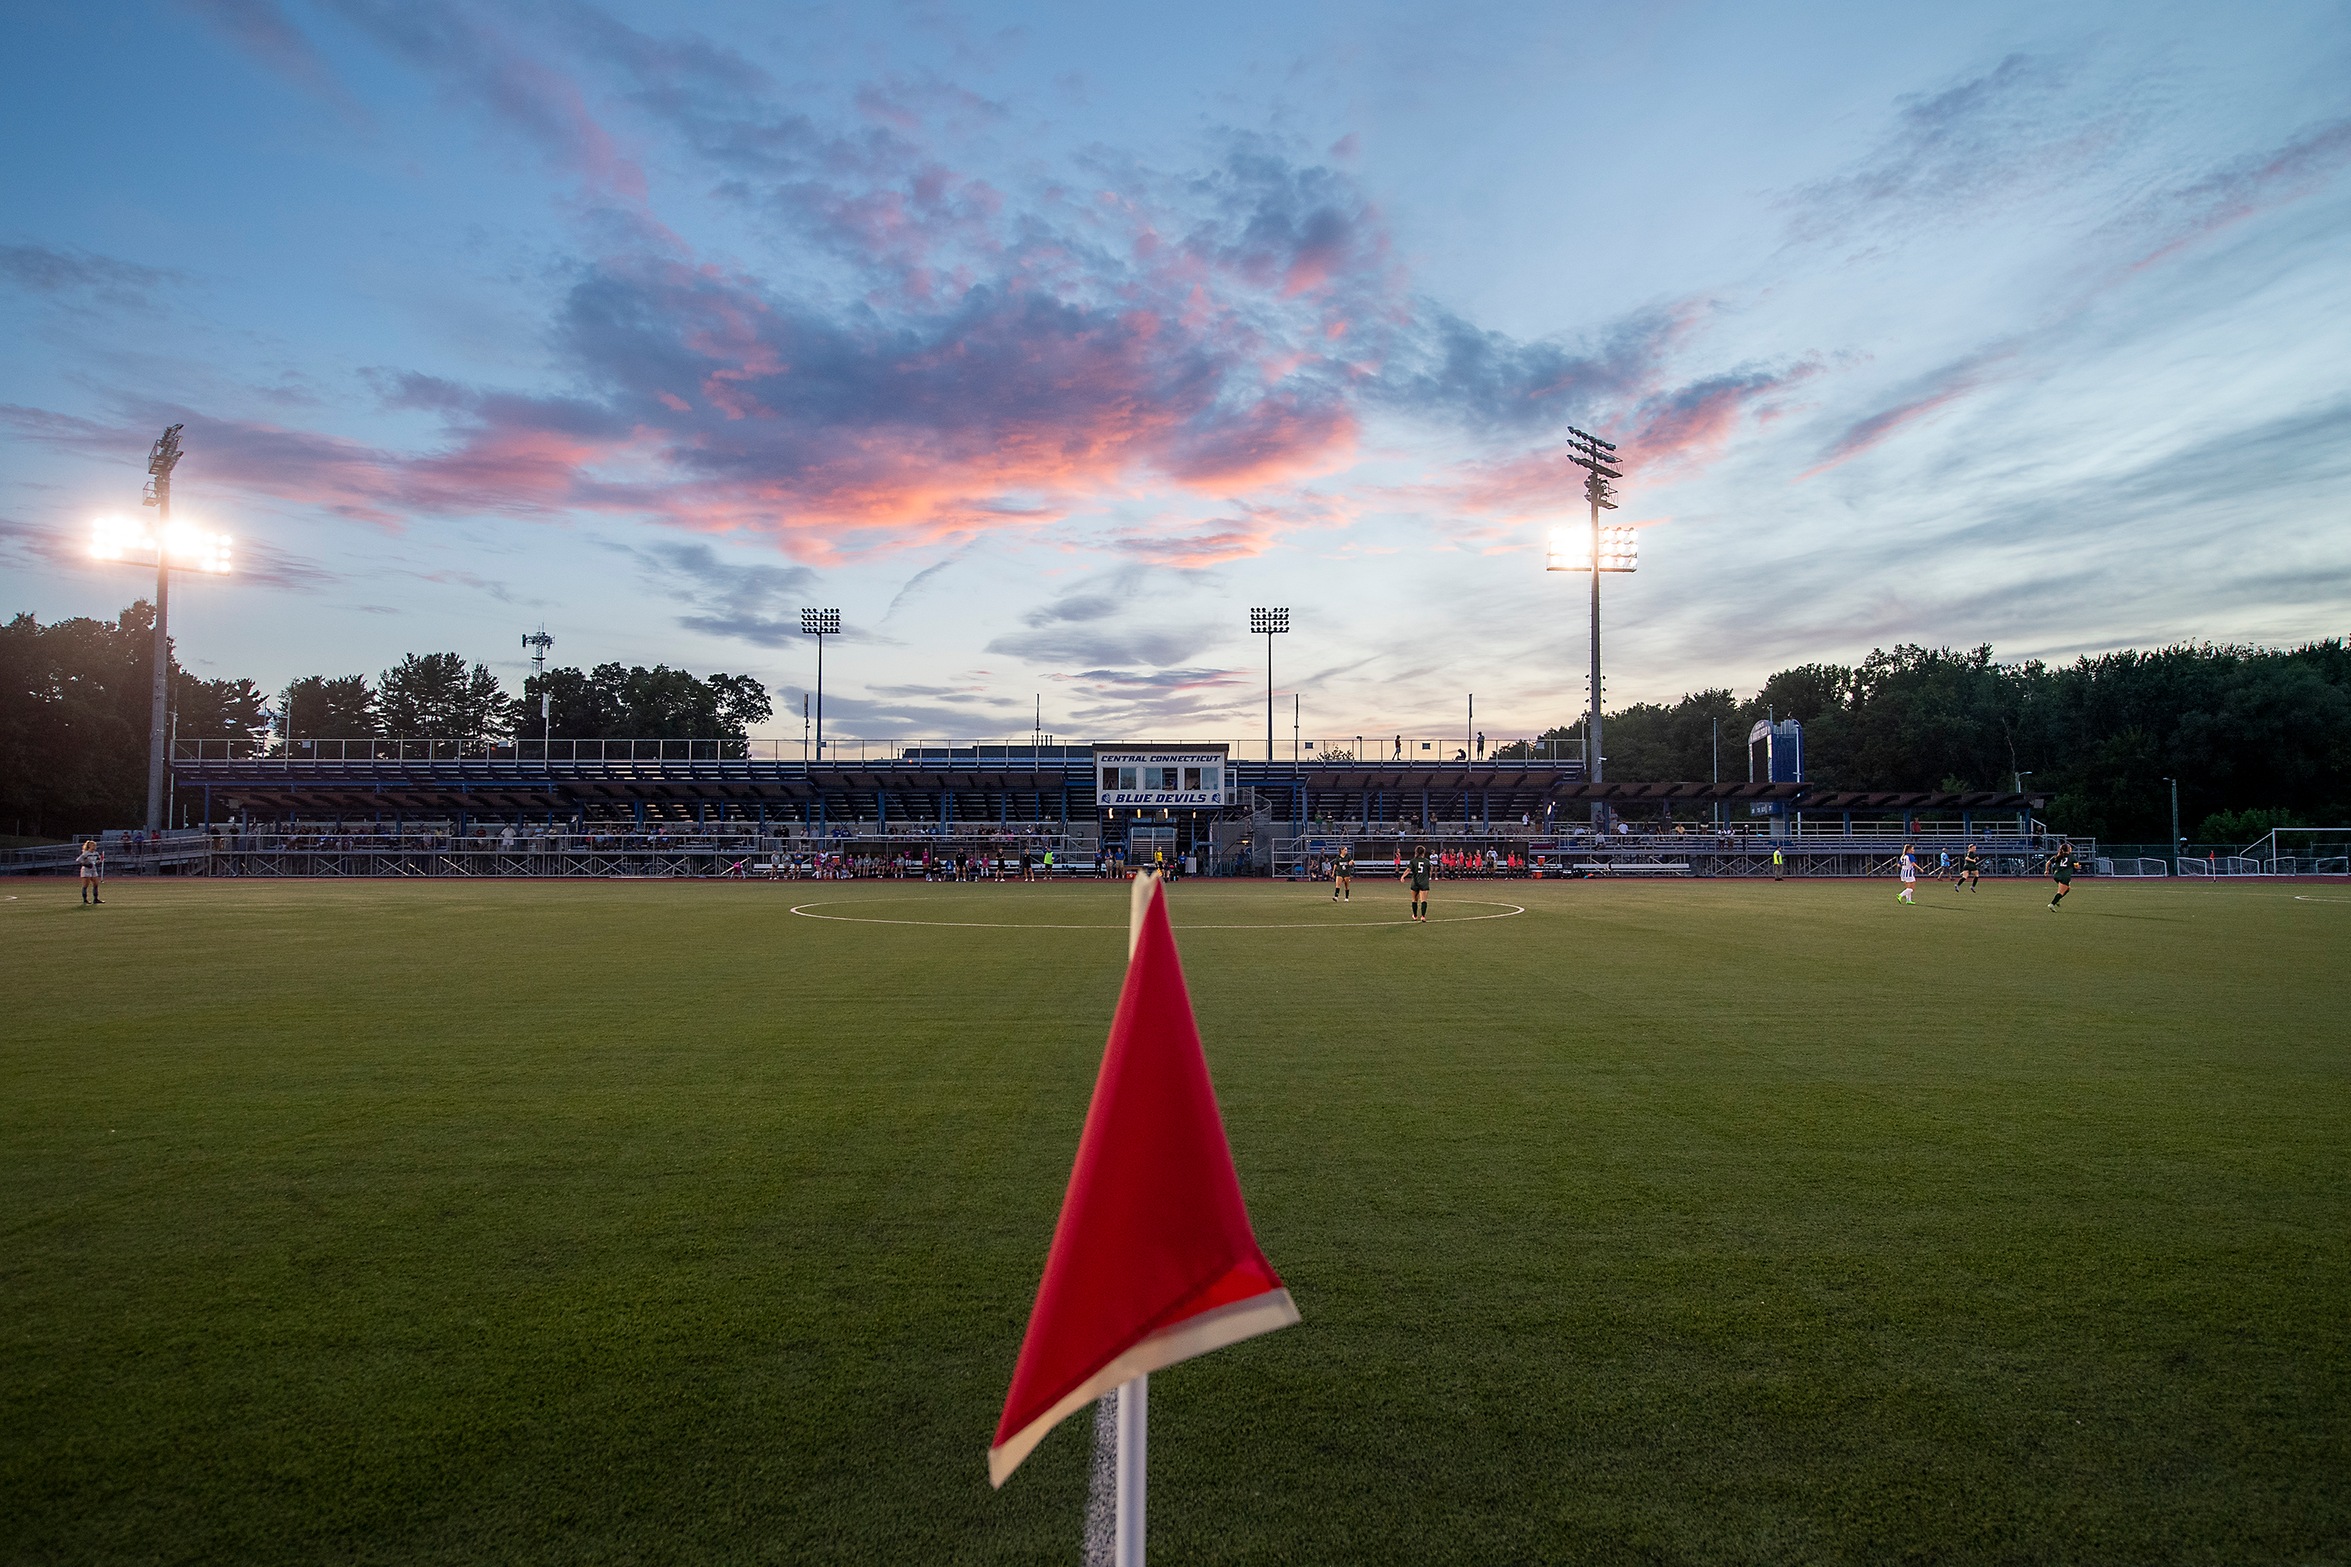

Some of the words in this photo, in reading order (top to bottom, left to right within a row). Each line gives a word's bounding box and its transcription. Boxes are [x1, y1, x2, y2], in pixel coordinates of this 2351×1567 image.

[1115, 794, 1153, 803] BLUE
[1155, 794, 1207, 803] DEVILS
[2060, 857, 2068, 867] 12
[1417, 862, 1424, 873] 5
